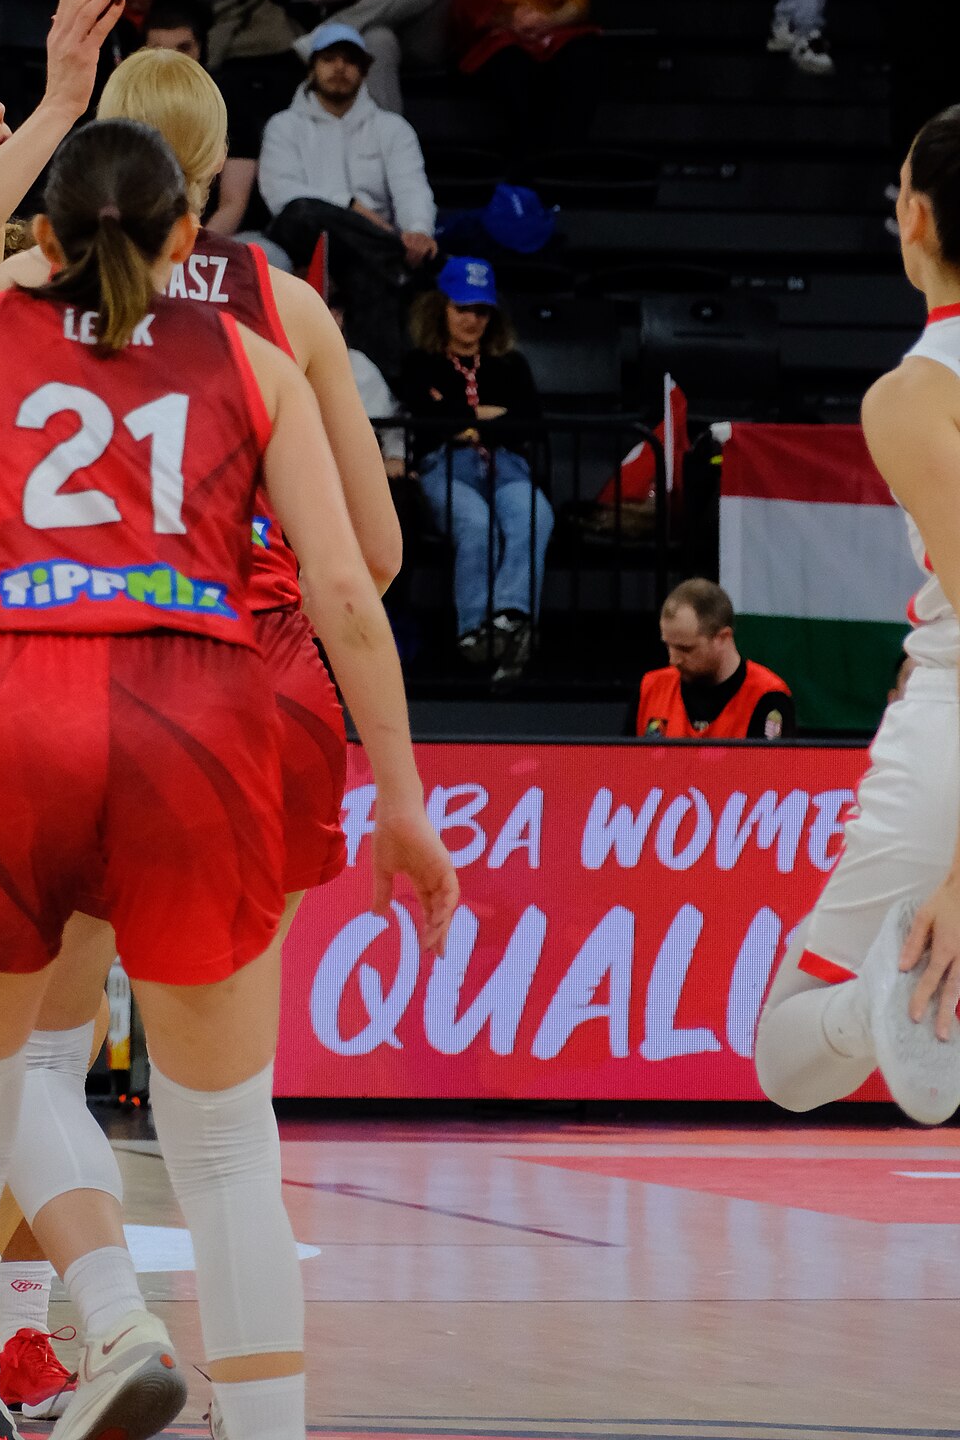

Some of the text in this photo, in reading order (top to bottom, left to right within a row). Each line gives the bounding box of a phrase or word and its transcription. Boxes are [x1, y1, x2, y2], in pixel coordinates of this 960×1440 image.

[159, 253, 229, 303] ASZ
[63, 308, 156, 346] LEK
[15, 382, 189, 535] 21
[341, 783, 544, 871] FBA
[309, 899, 800, 1061] QUALI
